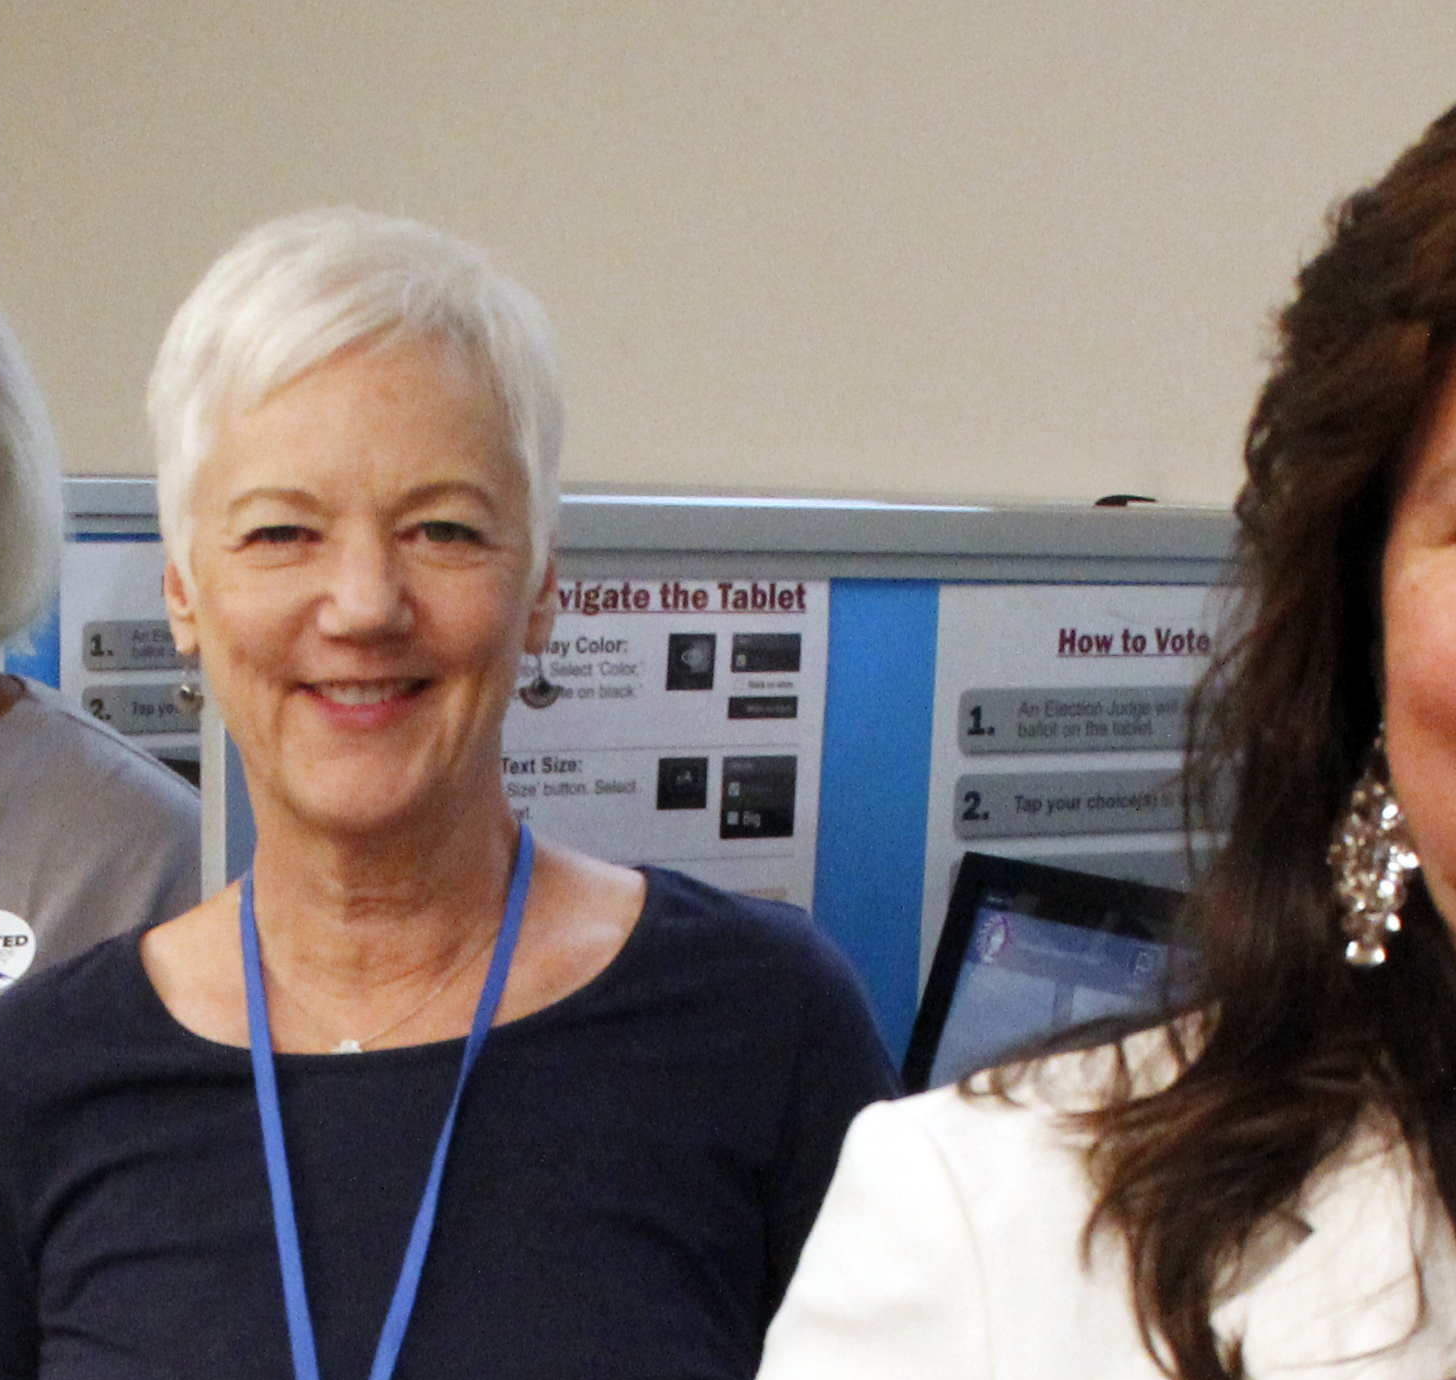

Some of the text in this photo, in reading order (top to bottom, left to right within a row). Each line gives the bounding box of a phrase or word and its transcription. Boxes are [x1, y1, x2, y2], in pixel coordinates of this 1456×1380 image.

[660, 582, 708, 609] the
[718, 583, 807, 611] Tablet
[90, 633, 113, 656] 1.
[1058, 629, 1210, 654] How to Vote
[89, 698, 111, 720] 2.
[967, 705, 995, 735] 1.
[1018, 702, 1039, 716] An
[1107, 701, 1150, 719] Judge
[542, 757, 583, 773] Size:
[595, 779, 636, 795] Select
[961, 790, 990, 820] 2.
[1014, 795, 1042, 813] Tap
[1046, 798, 1081, 814] your
